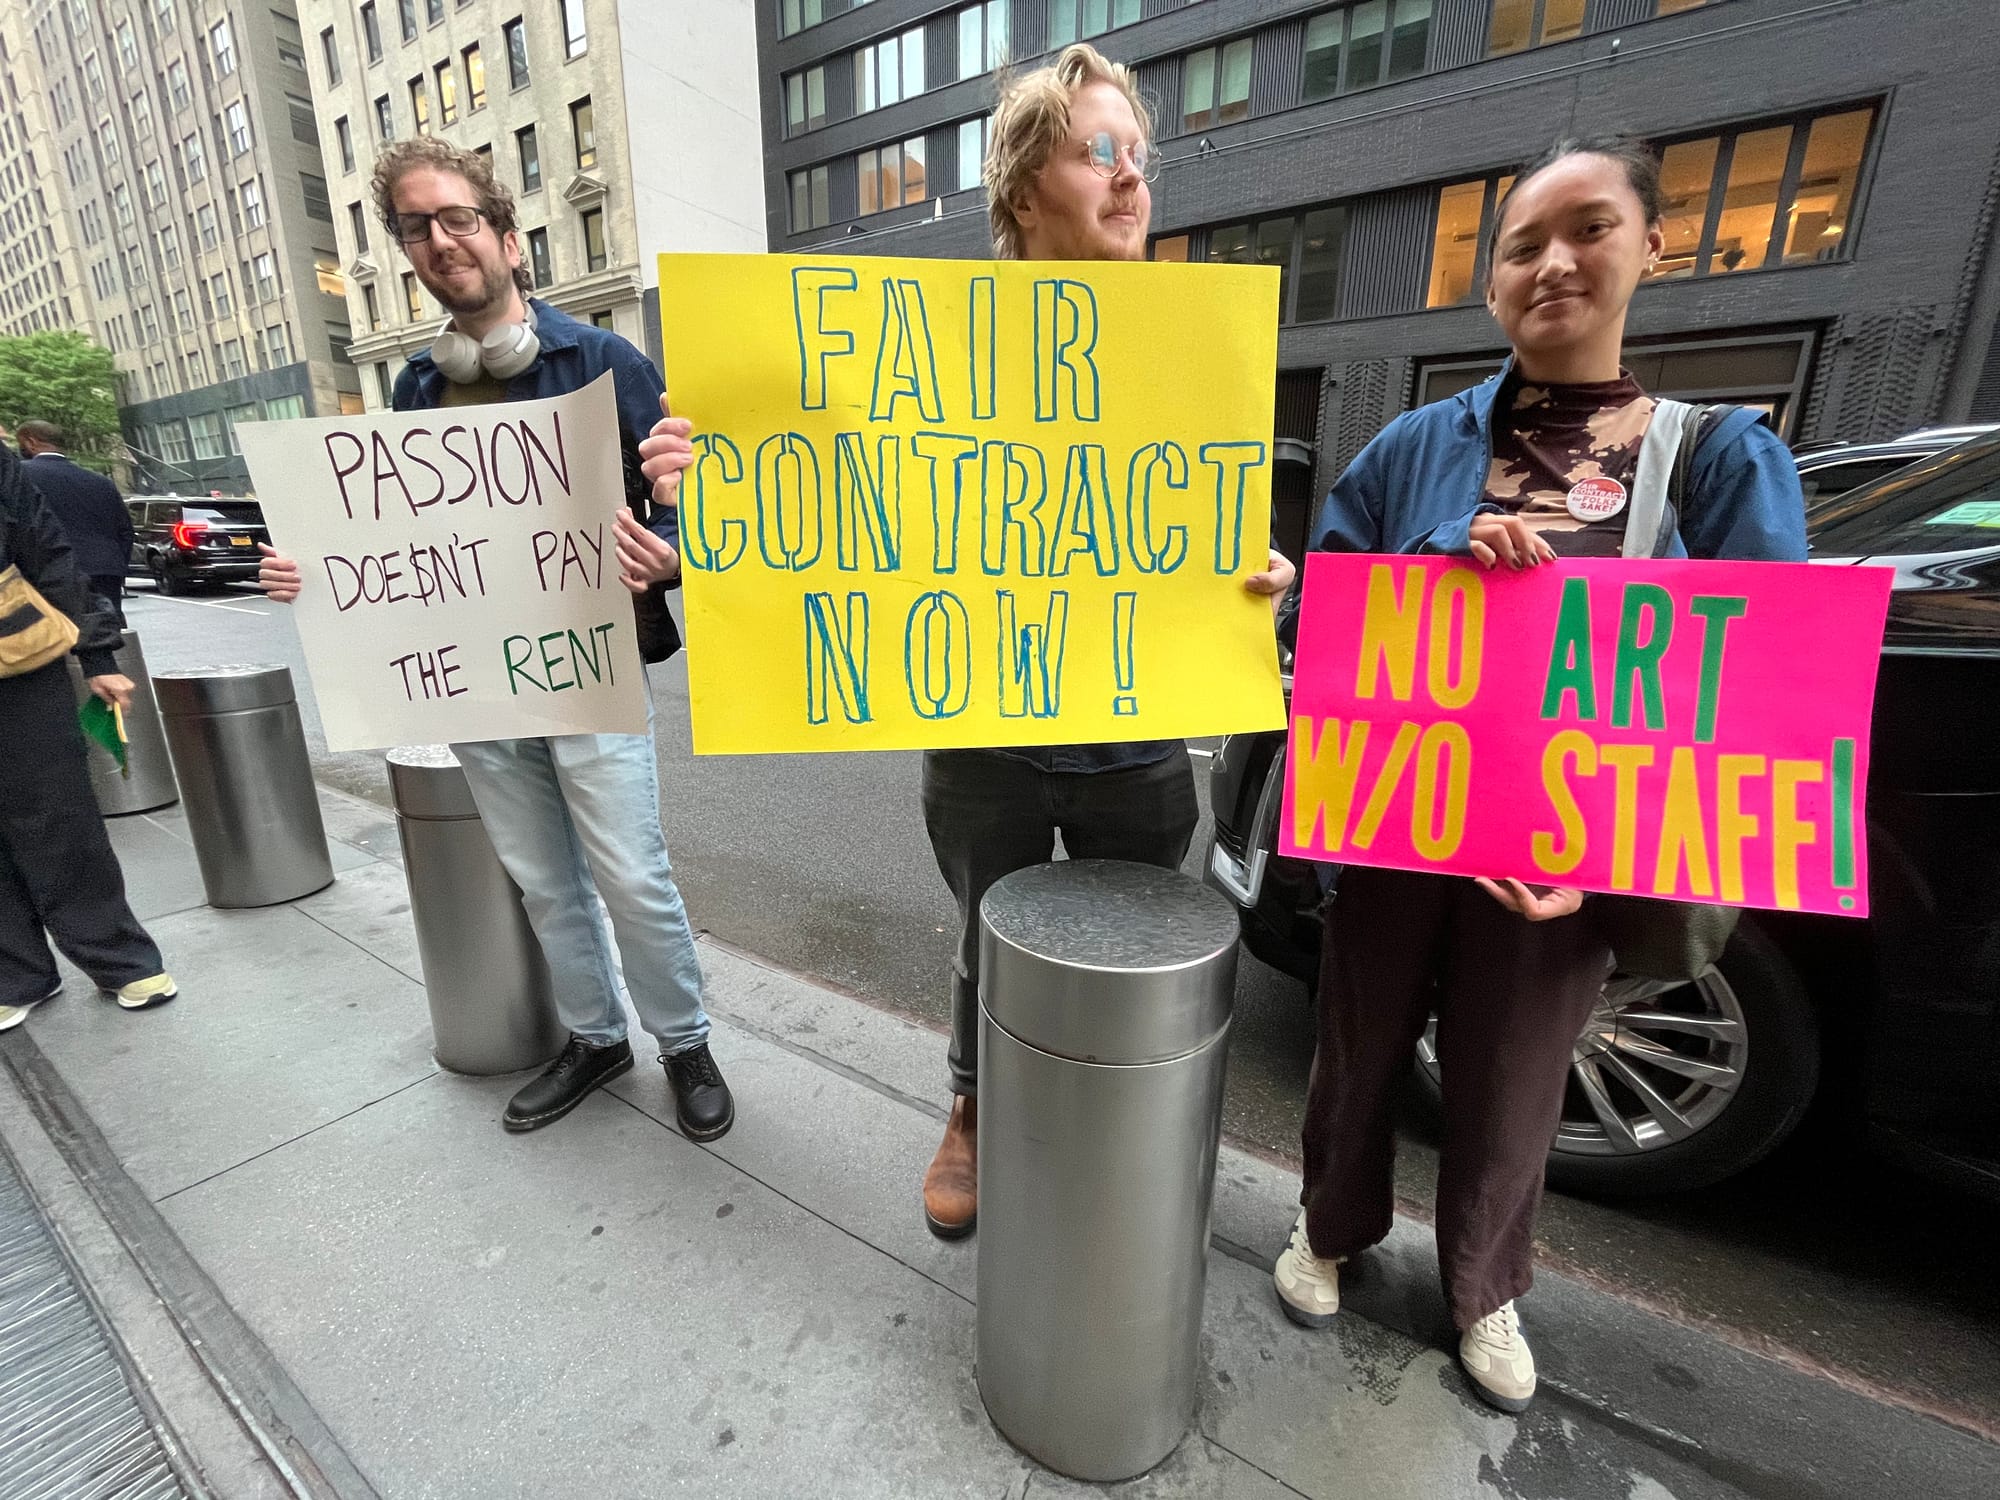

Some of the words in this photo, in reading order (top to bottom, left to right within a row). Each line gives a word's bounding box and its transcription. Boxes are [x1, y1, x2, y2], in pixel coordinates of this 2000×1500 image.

[791, 266, 1101, 422] FAIR
[324, 411, 571, 520] PASSION
[677, 431, 1265, 577] CONTRACT
[1579, 502, 1613, 512] SAKE!
[323, 533, 489, 612] DOE$N'T
[531, 523, 603, 592] PAY
[389, 645, 468, 701] THE
[503, 622, 615, 695] RENT
[1355, 564, 1486, 710] NO
[1540, 576, 1748, 744] ART
[1294, 715, 1472, 862] W/O
[1531, 729, 1856, 911] STAFF!
